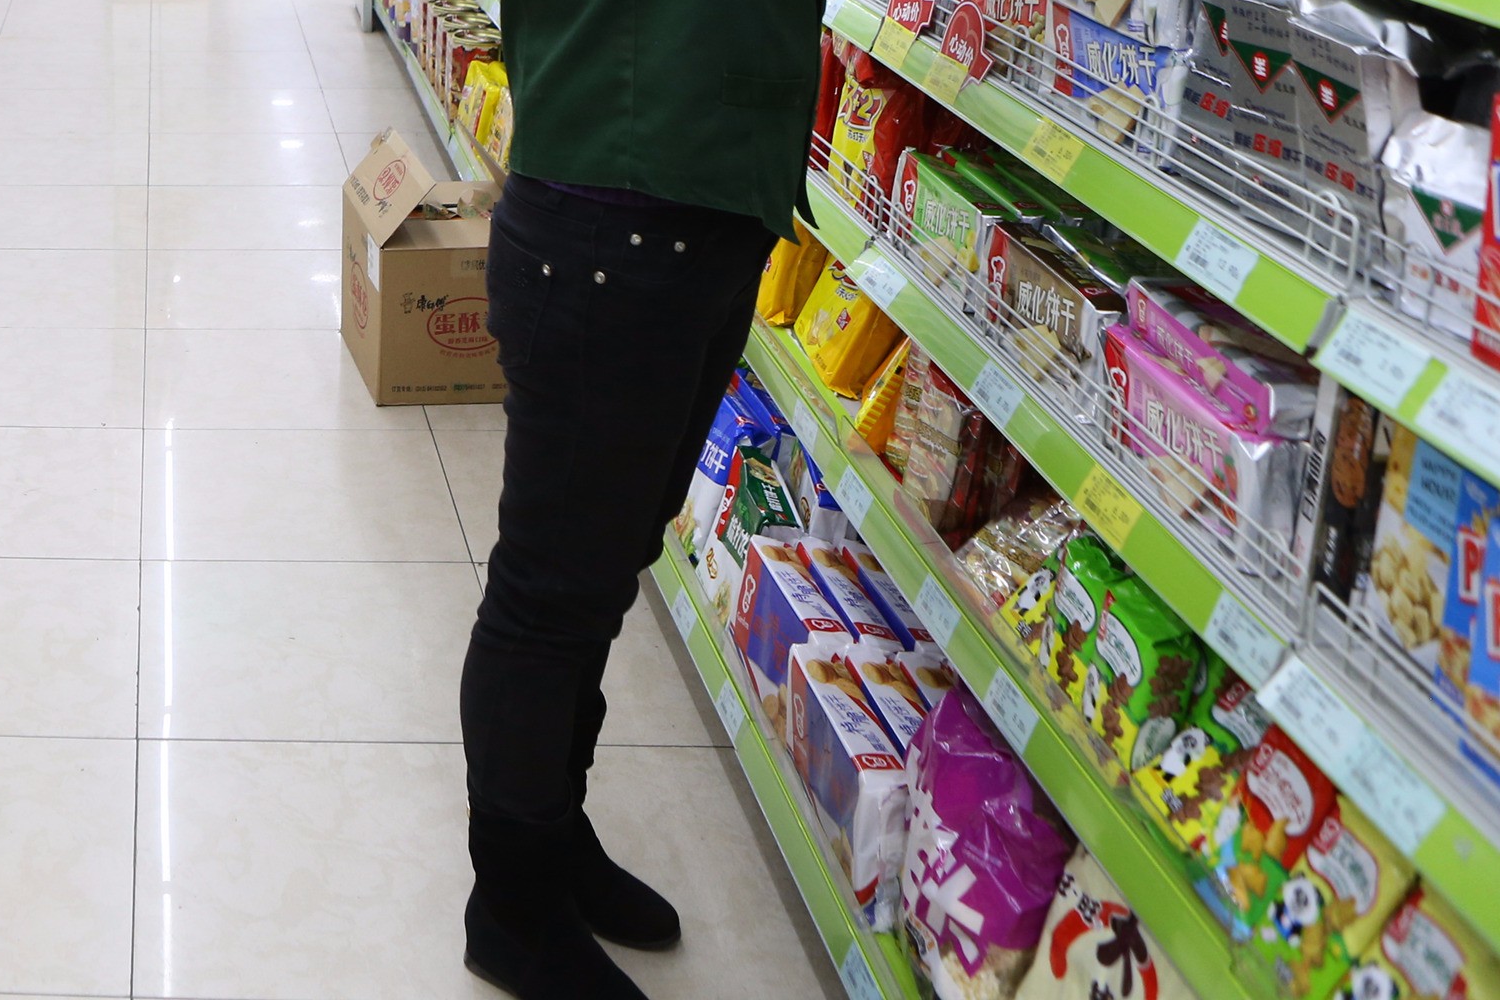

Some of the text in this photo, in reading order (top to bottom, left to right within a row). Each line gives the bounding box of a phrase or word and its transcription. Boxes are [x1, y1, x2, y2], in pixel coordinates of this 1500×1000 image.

[892, 5, 920, 24] 心动价
[949, 35, 975, 64] 心动价
[1087, 43, 1156, 87] 威化饼干
[922, 198, 971, 242] 威化饼干
[434, 312, 489, 335] 蛋酥
[1017, 280, 1076, 337] 威化饼干
[1146, 404, 1223, 463] 威化饼干
